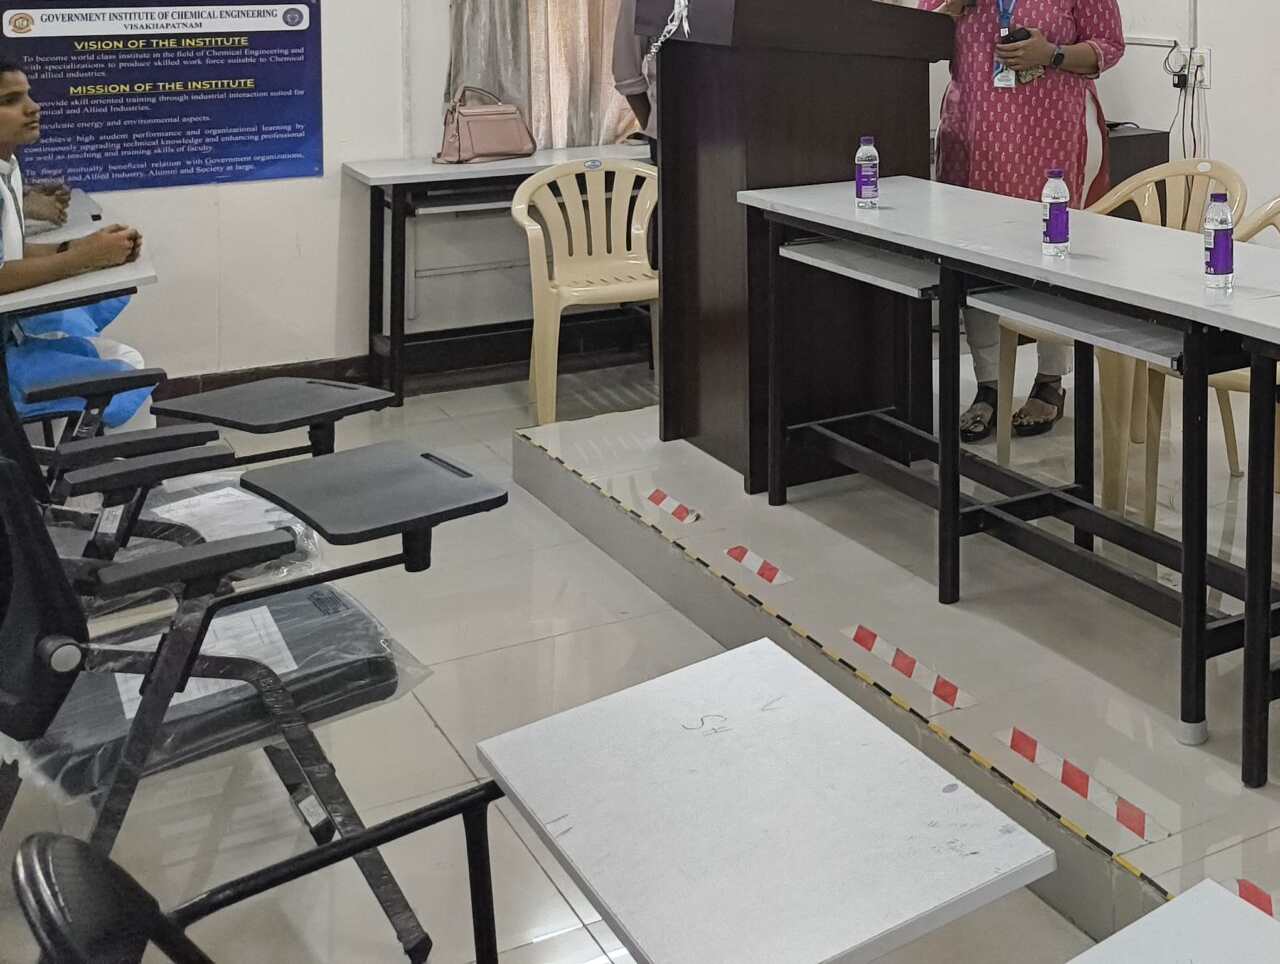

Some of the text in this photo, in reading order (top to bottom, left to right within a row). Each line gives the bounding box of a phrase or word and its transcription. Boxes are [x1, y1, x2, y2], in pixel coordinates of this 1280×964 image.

[40, 8, 278, 23] GOVERNMENT INSTITUTE OF CHEMICAL ENGINEERING
[123, 21, 202, 30] VISAKHAPATNAM
[74, 37, 249, 50] VISION OF THE INSTITUTE
[36, 54, 68, 62] become
[71, 53, 94, 61] world
[244, 47, 288, 57] Engineering
[119, 60, 150, 69] produce
[206, 57, 225, 65] force
[227, 56, 256, 64] suitable
[40, 71, 63, 79] allied
[70, 79, 255, 95] MISSION OF THE INSTITUTE
[38, 99, 68, 107] rovide
